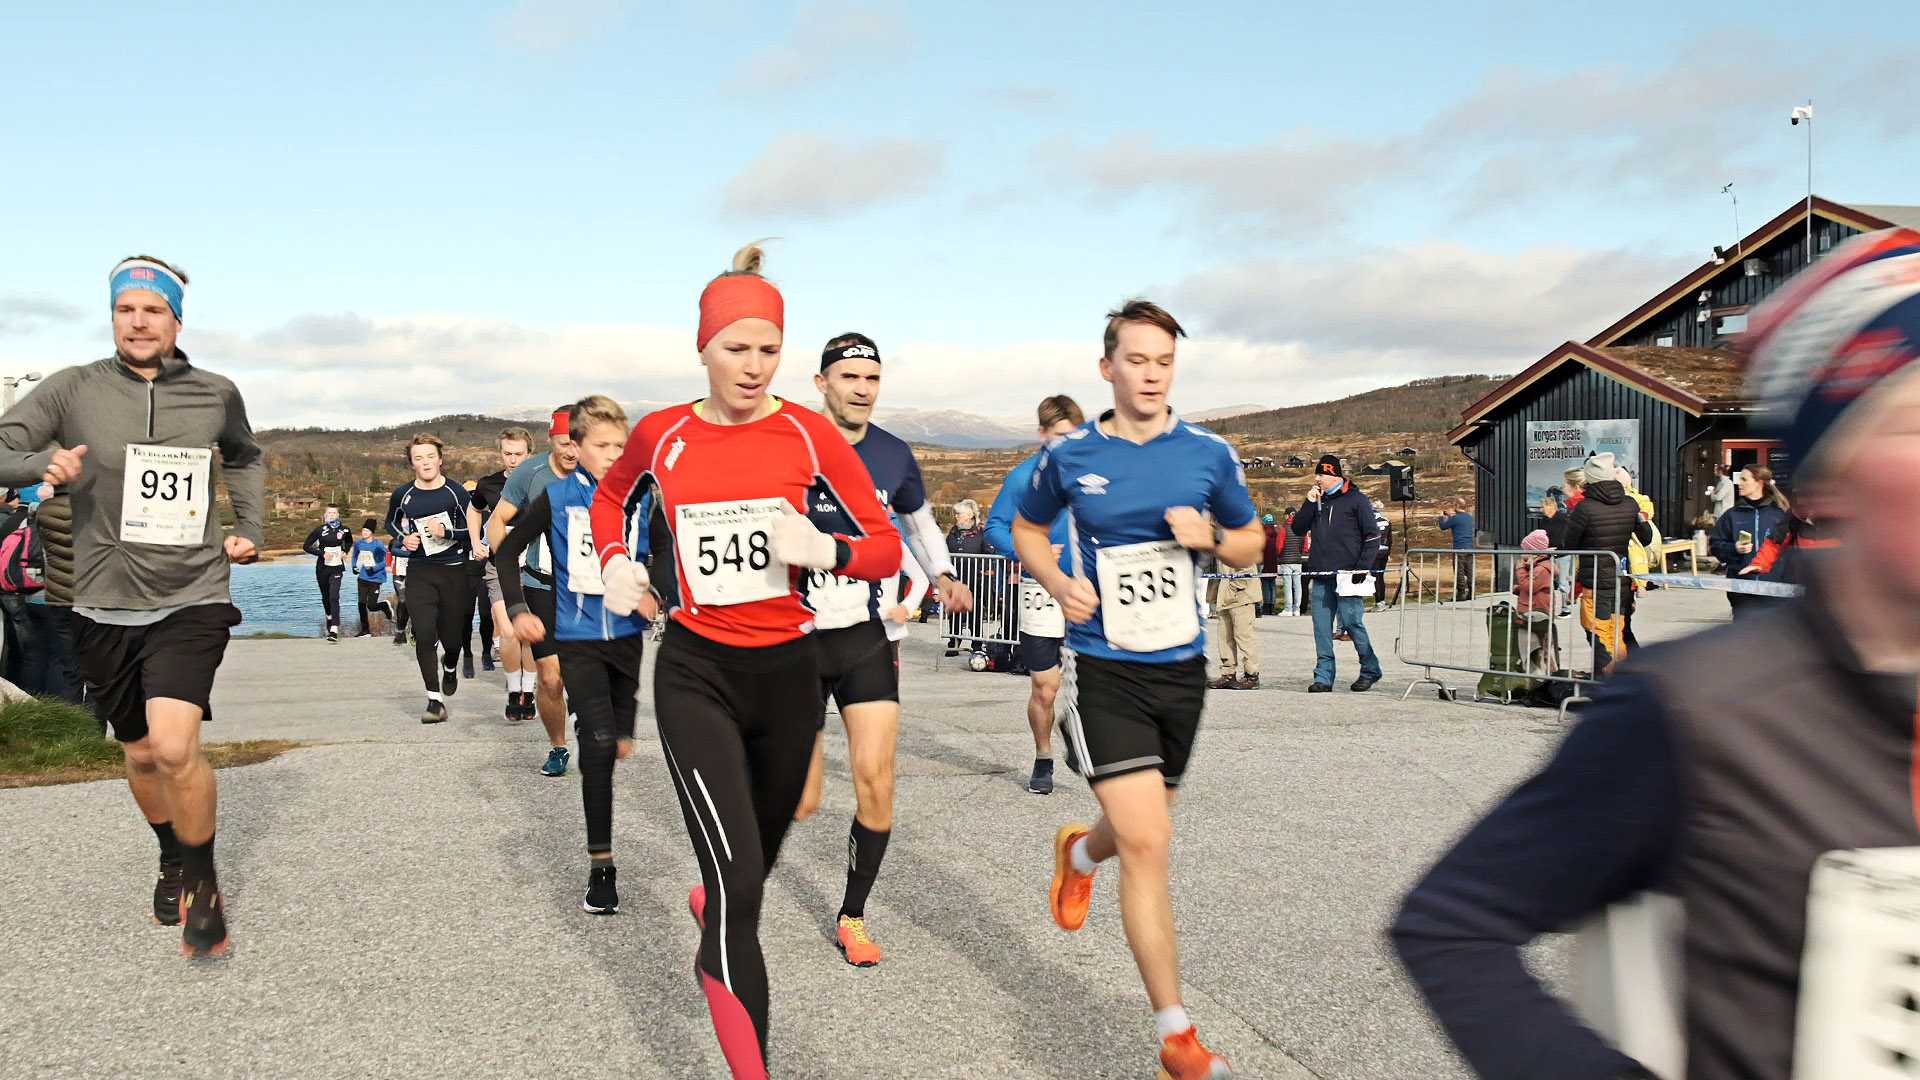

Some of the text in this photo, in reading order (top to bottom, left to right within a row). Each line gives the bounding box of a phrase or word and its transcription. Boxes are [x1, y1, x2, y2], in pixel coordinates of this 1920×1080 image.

[141, 469, 193, 501] 931
[698, 530, 771, 576] 548
[1118, 566, 1177, 605] 538
